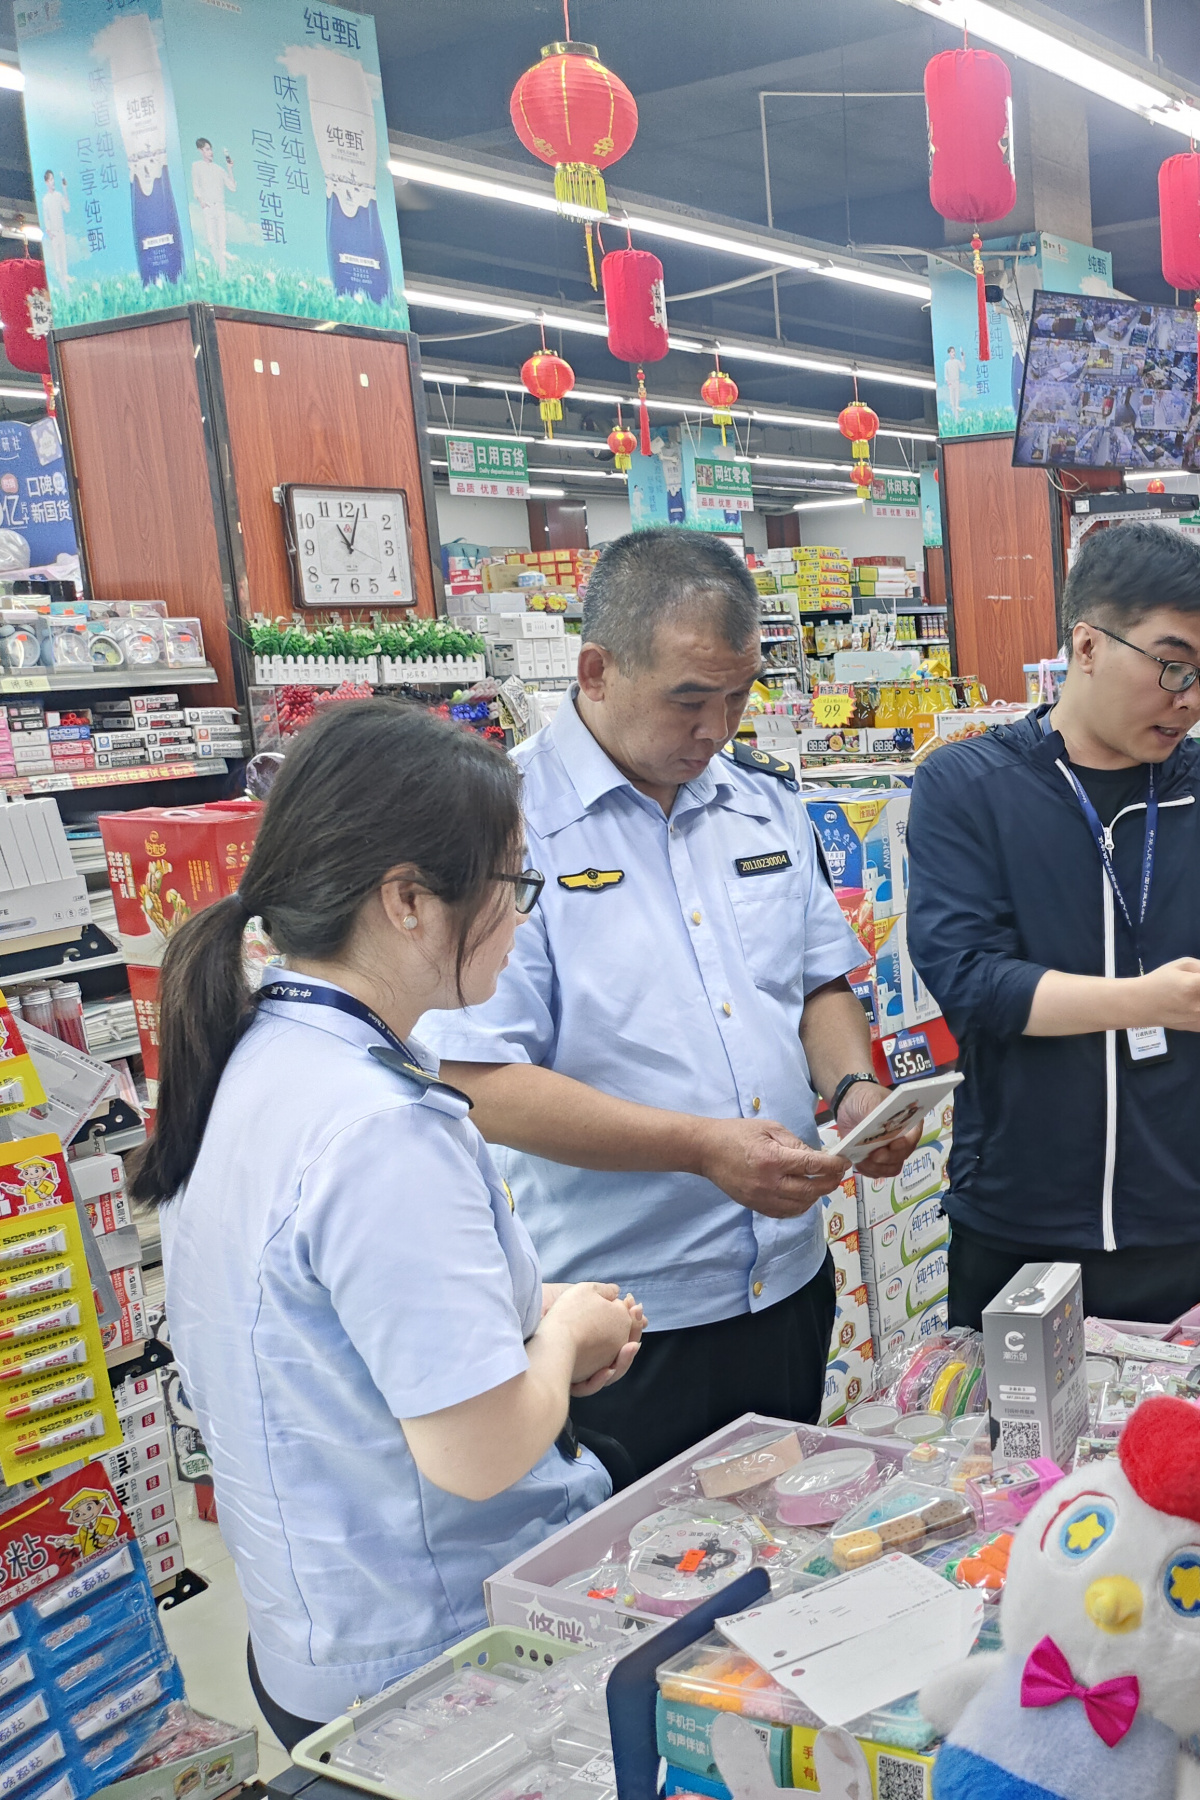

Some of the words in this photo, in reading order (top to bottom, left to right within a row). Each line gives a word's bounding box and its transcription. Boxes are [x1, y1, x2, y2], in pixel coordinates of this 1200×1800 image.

[303, 7, 361, 50] 纯甄
[126, 96, 156, 121] 纯甄
[88, 67, 119, 190] 味道纯纯
[273, 75, 310, 195] 味道纯纯
[326, 124, 364, 151] 纯甄
[76, 137, 106, 253] 尽享纯甄
[251, 129, 287, 245] 尽享纯甄
[1088, 254, 1107, 275] 纯甄
[477, 446, 525, 468] 日用百货
[715, 465, 750, 484] 网红零食
[457, 482, 475, 494] 品质
[480, 484, 499, 495] 优惠
[507, 485, 525, 496] 便利
[887, 479, 917, 496] 休闲零食
[31, 500, 72, 523] 新国货
[318, 501, 330, 518] 11
[338, 502, 355, 518] 12
[361, 503, 368, 519] 1
[702, 498, 715, 507] 品质
[719, 499, 731, 508] 优惠
[737, 500, 749, 509] 便利
[297, 512, 315, 529] 10
[382, 515, 391, 530] 2
[305, 540, 315, 556] 9
[385, 540, 394, 556] 3
[308, 566, 319, 583] 8
[387, 567, 397, 582] 4
[331, 578, 340, 594] 7
[350, 578, 360, 594] 6
[369, 578, 379, 594] 5
[820, 687, 849, 695] 新货上市
[902, 1151, 932, 1178] 纯牛奶
[830, 1220, 841, 1231] 3.3
[917, 1256, 946, 1285] 纯牛奶
[842, 1327, 852, 1339] 3.3
[116, 1451, 129, 1477] ink
[67, 1569, 110, 1600] 啥都粘
[105, 1689, 145, 1721] 啥都粘
[2, 1756, 44, 1791] 啥都粘
